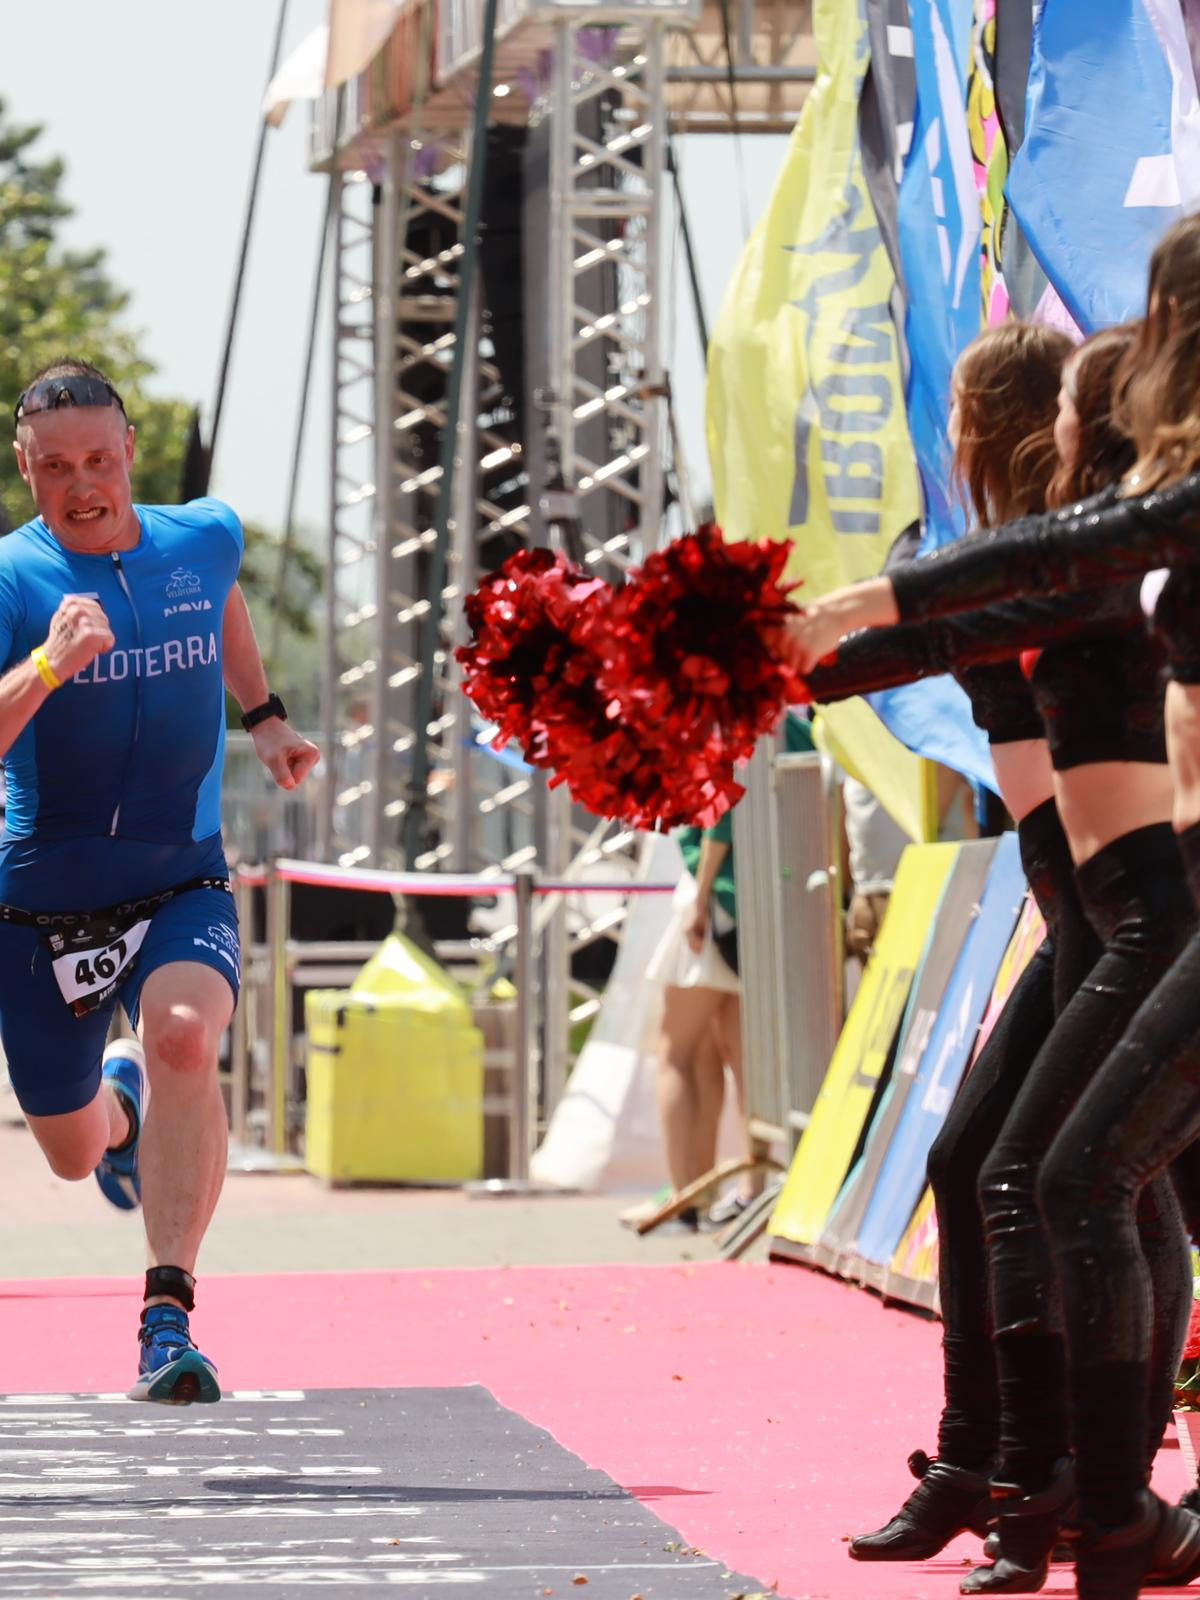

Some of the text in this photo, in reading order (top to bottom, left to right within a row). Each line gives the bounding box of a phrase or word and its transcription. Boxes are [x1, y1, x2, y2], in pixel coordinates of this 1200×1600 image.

[163, 599, 213, 618] NOVA
[73, 632, 218, 684] ELOTERRA
[75, 938, 128, 986] 467
